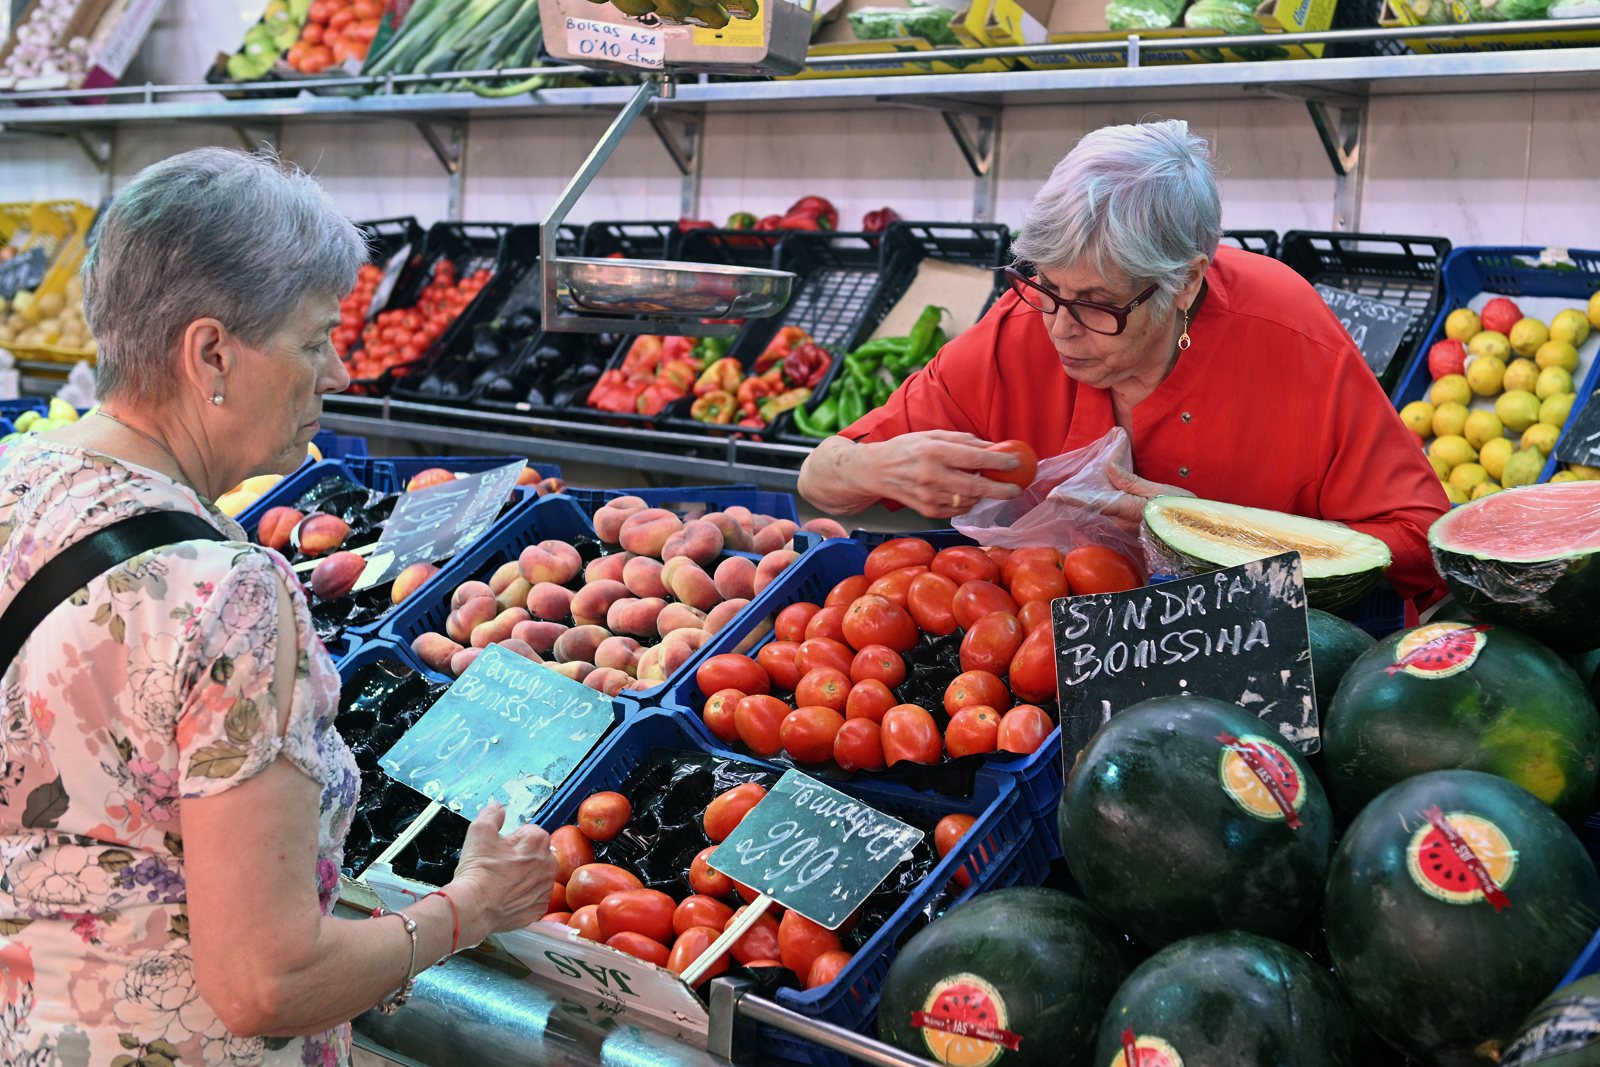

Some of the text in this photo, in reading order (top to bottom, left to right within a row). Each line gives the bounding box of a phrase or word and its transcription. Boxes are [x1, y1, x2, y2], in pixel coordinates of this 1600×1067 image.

[1255, 766, 1272, 784] JAS
[544, 950, 641, 997] JAS
[952, 1019, 968, 1035] JAS
